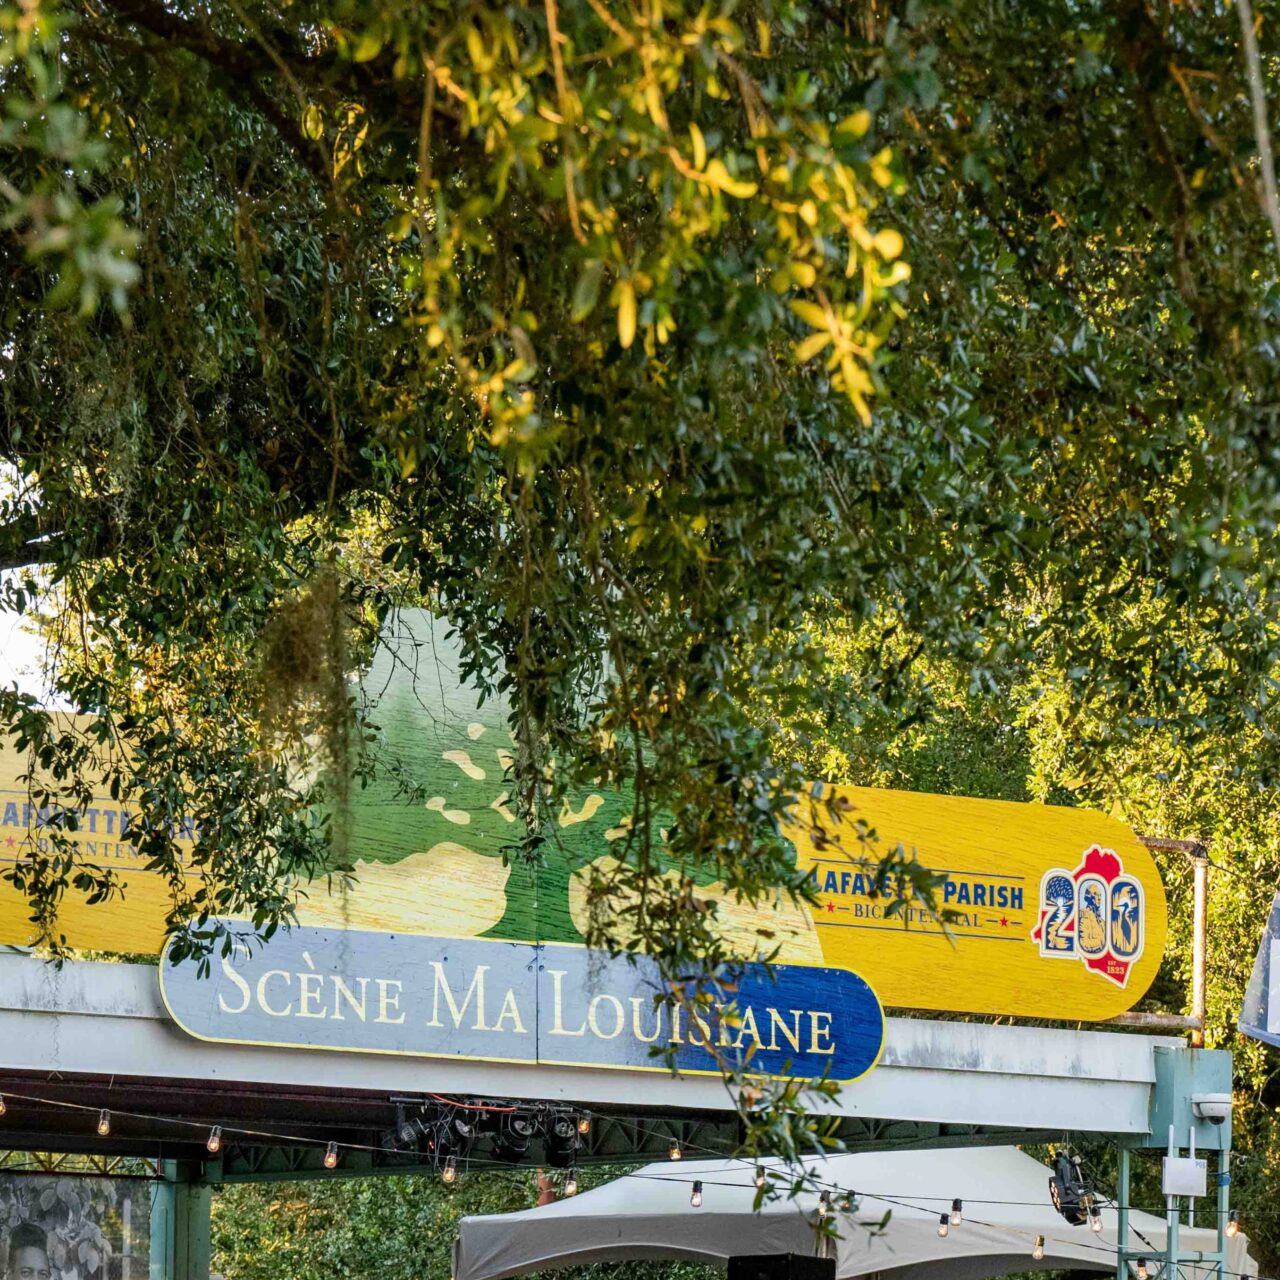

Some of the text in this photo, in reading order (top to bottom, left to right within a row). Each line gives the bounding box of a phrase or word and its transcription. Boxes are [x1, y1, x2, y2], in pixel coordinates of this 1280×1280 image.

[943, 881, 1023, 909] PARISH
[1040, 868, 1145, 960] 200
[218, 944, 835, 1055] SCÈNE MA LOUISIANE
